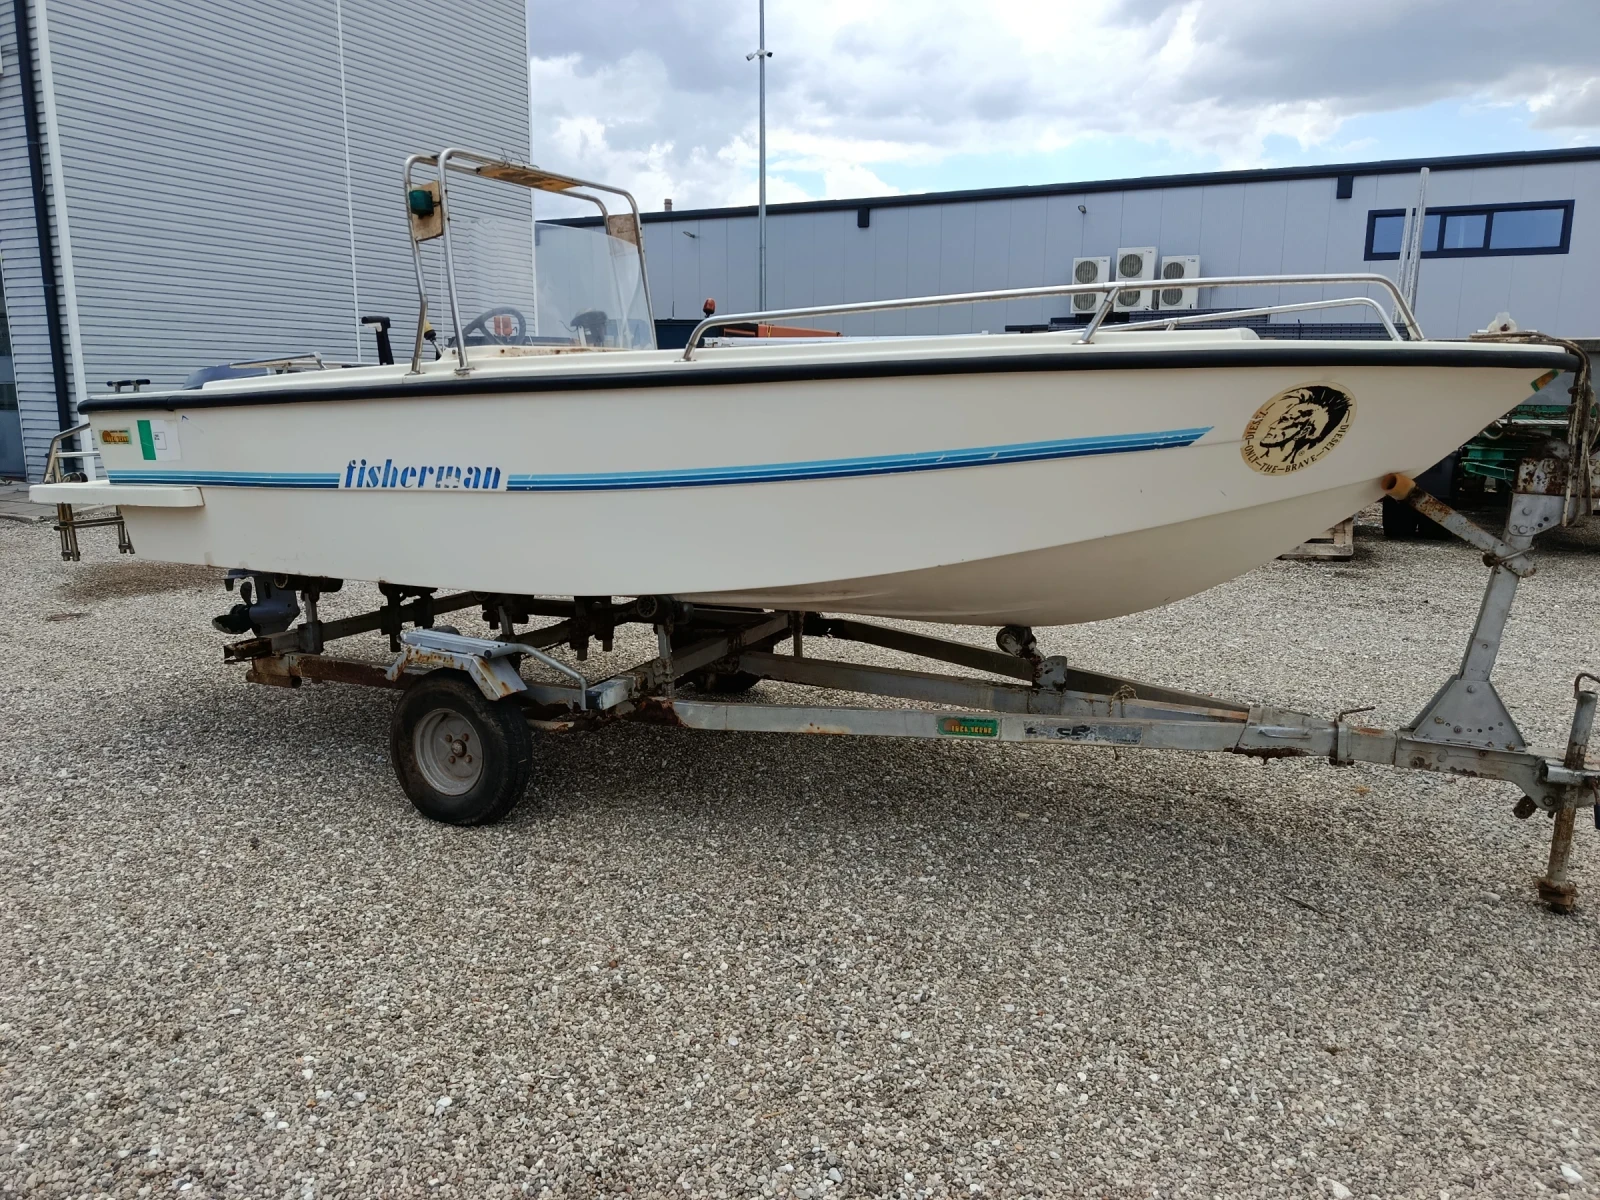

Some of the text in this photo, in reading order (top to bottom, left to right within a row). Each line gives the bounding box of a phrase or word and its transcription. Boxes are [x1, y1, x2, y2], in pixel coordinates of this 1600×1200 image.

[1244, 411, 1349, 473] DIESEL ONLY THE BRAVE DIESEL
[344, 458, 501, 489] fisherman
